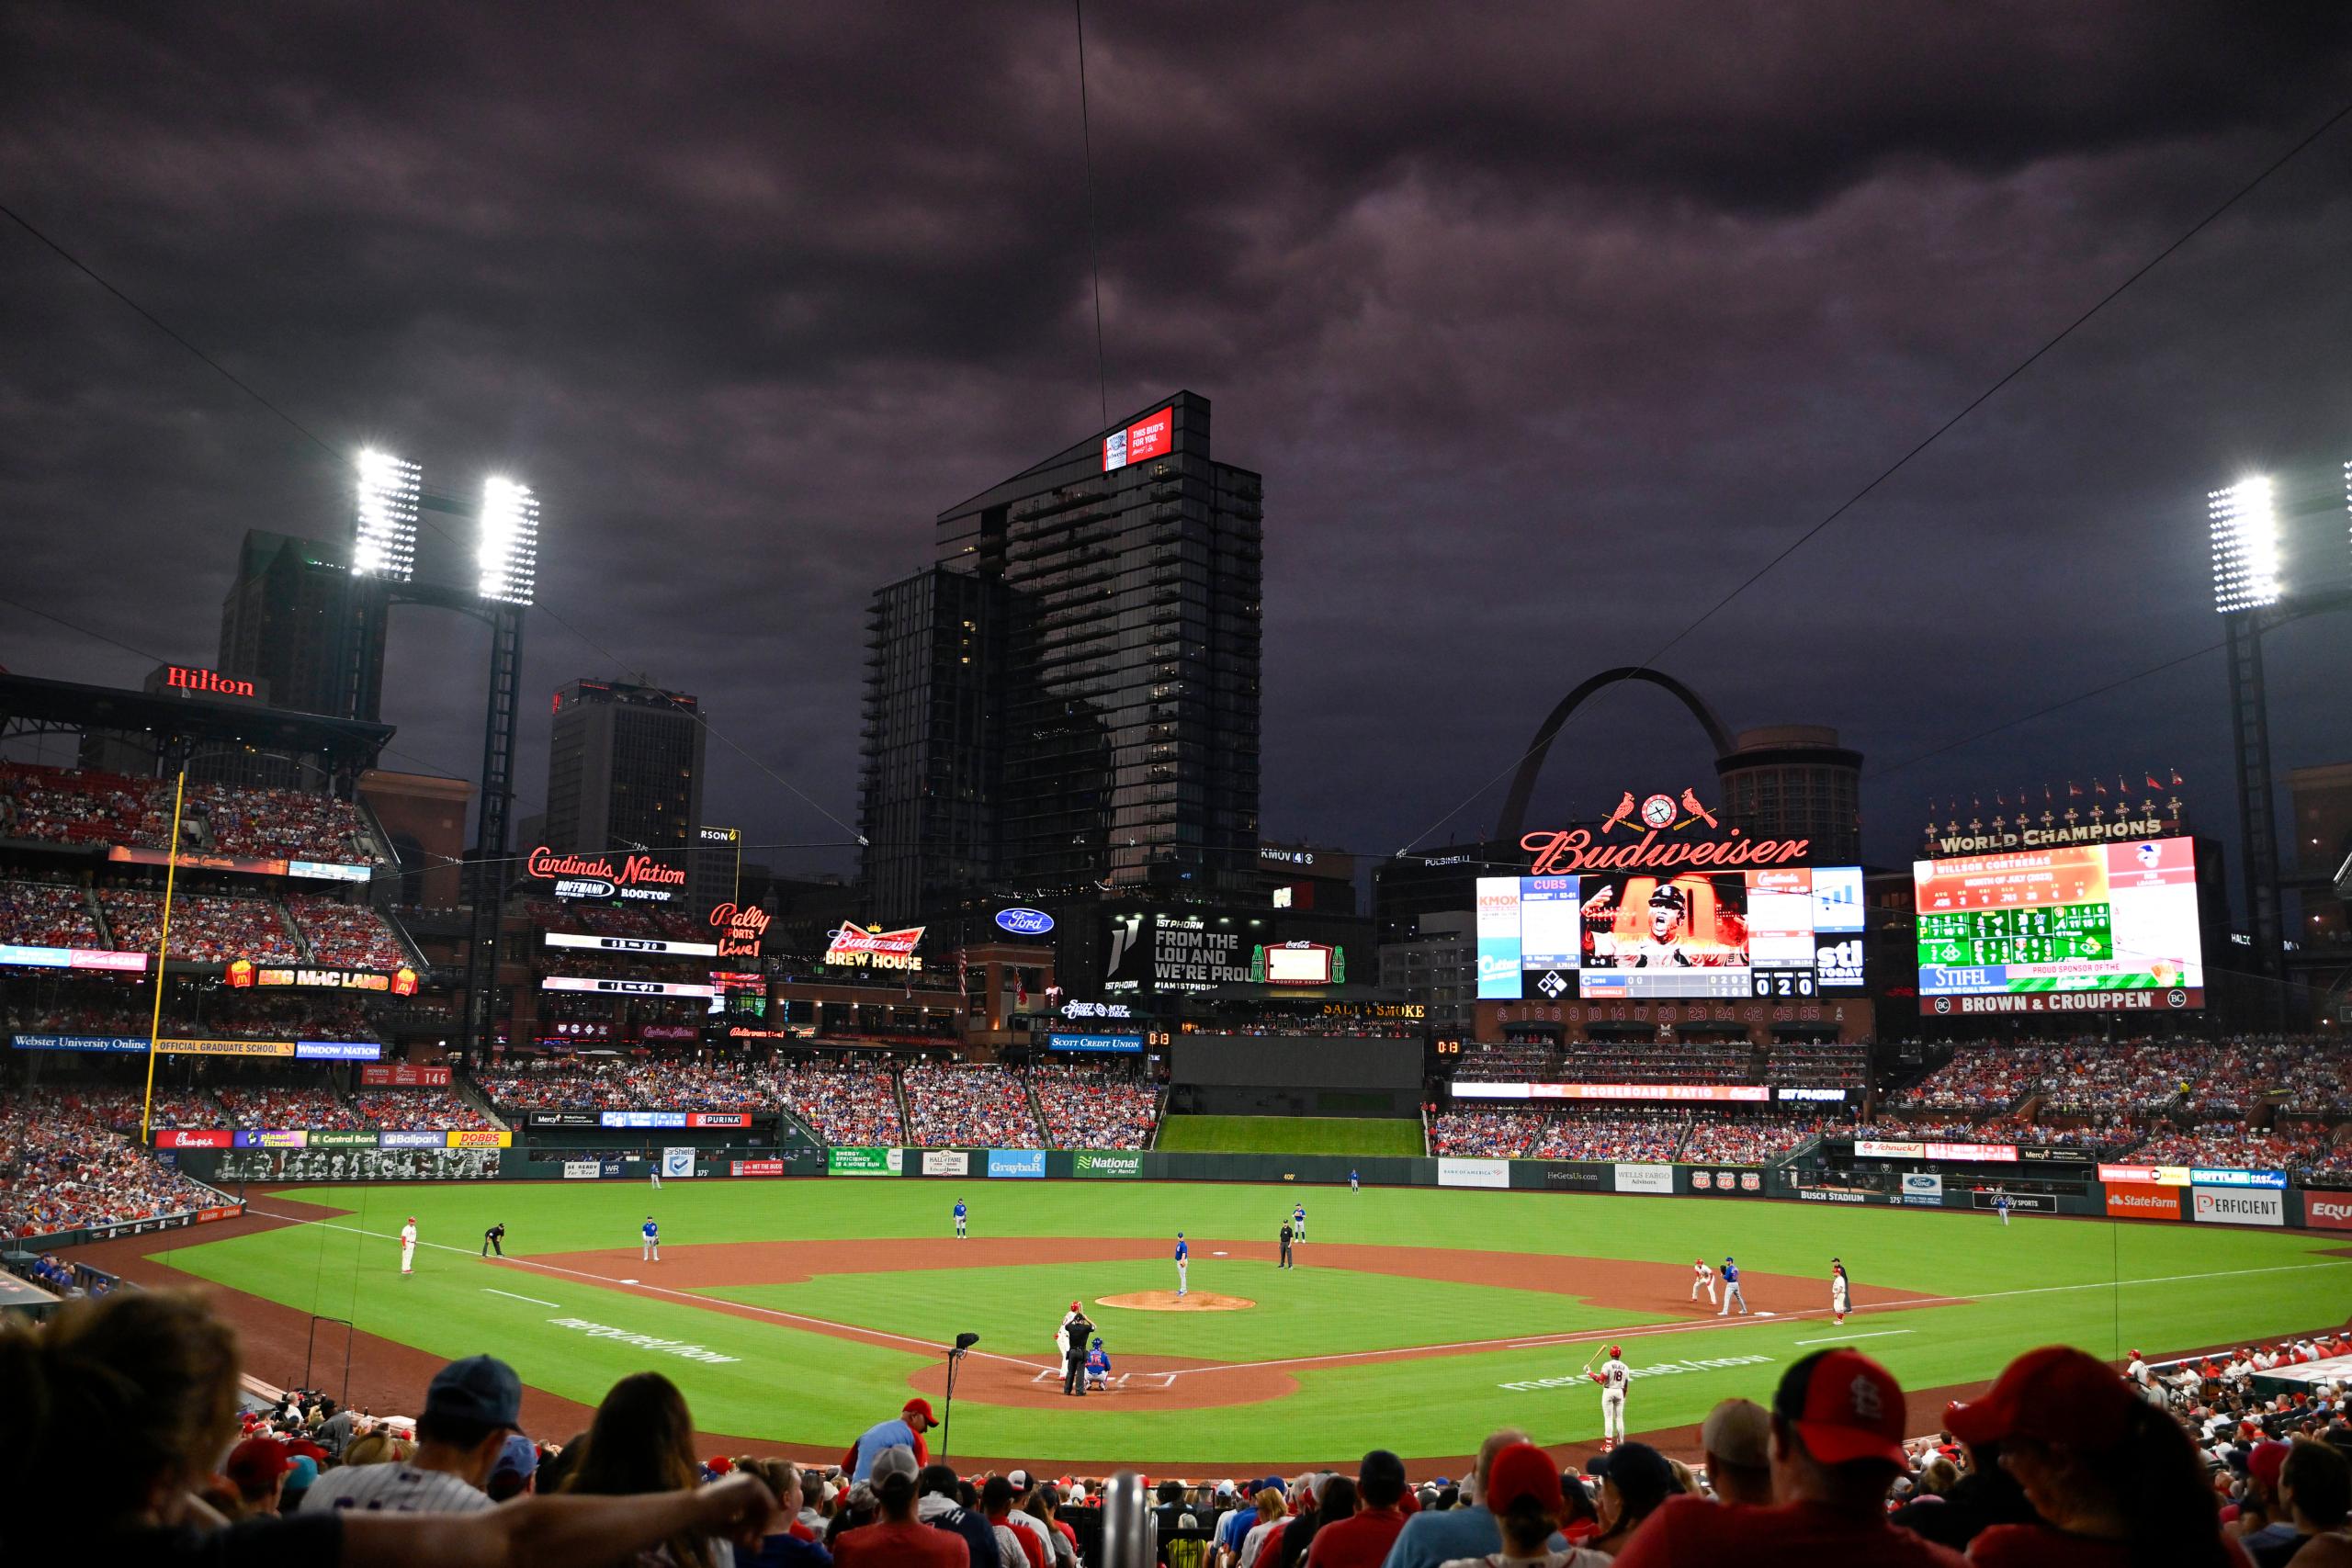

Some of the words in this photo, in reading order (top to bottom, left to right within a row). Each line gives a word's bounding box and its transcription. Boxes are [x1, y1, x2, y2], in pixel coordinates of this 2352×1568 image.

[1133, 428, 1146, 439] THIS
[1147, 423, 1164, 434] BUD'S
[1132, 438, 1144, 447] FOR
[167, 667, 254, 697] Hilton
[701, 830, 728, 840] RSON
[1940, 834, 2018, 853] WORLD
[2023, 818, 2162, 845] CHAMPIONS
[1261, 848, 1291, 862] KMOV
[1294, 853, 1303, 863] 4
[1521, 829, 1809, 875] Budweiser
[528, 846, 614, 878] Cardinals
[614, 855, 685, 886] Nation
[1425, 855, 1470, 866] POLSINELLI
[1937, 862, 1983, 874] WILLSON
[1986, 857, 2051, 870] CONTRERAS
[556, 880, 605, 895] HOFFMANN
[1534, 879, 1566, 889] CUBS
[1964, 877, 1994, 886] MONTH
[1996, 875, 2007, 885] OF
[621, 888, 671, 901] ROOFTOP
[1479, 896, 1518, 906] KMOX
[710, 903, 771, 935] Bally
[1009, 909, 1042, 931] Ford
[722, 928, 755, 939] SPORTS
[1156, 931, 1203, 947] FROM
[1206, 933, 1238, 949] THE
[718, 939, 761, 956] Live!
[1285, 941, 1311, 949] Coca-Cola
[826, 951, 869, 966] BREW
[873, 954, 922, 970] HOUSE
[1156, 947, 1186, 963] LOU
[1191, 949, 1227, 964] AND
[1816, 941, 1863, 967] stl
[1155, 963, 1206, 980] WE'RE
[1212, 966, 1254, 982] PROU
[1818, 967, 1863, 977] TODAY
[2059, 964, 2093, 973] SPONSOR
[258, 969, 295, 985] BIG
[297, 969, 340, 987] MAC
[342, 973, 389, 990] LAND
[1936, 968, 1990, 987] STIFEL
[1155, 982, 1218, 991] #IAM1STPHOR
[1757, 979, 1769, 995] 0
[1778, 979, 1791, 995] 2
[1799, 979, 1812, 995] 0
[1962, 996, 2027, 1011] BROWN
[2032, 998, 2043, 1010] &
[2050, 992, 2152, 1010] CROUPPEN
[2171, 994, 2183, 1002] BC
[1378, 1005, 1424, 1018] SMOKE
[1521, 1007, 1527, 1021] 1
[1535, 1007, 1544, 1021] 2
[1552, 1007, 1561, 1021] 6
[1569, 1007, 1578, 1021] 9
[1588, 1007, 1602, 1021] 10
[1611, 1007, 1625, 1021] 14
[1634, 1007, 1648, 1021] 17
[1658, 1007, 1676, 1021] 20
[1688, 1007, 1707, 1021] 23
[1715, 1007, 1735, 1021] 24
[1744, 1007, 1763, 1021] 42
[1773, 1007, 1792, 1021] 45
[1800, 1007, 1819, 1021] 85
[15, 1035, 55, 1046] Webster
[59, 1038, 110, 1049] University
[113, 1039, 146, 1050] Online
[1052, 1038, 1079, 1046] SCOTT
[1080, 1038, 1111, 1047] CREDIT
[1113, 1039, 1139, 1048] UNION
[1149, 1032, 1169, 1045] 0:13
[160, 1042, 197, 1051] OFFICIAL
[200, 1043, 243, 1053] GRADUATE
[246, 1044, 277, 1054] SCHOOL
[297, 1044, 340, 1055] WINDOW
[343, 1045, 379, 1055] NATION
[1438, 1042, 1458, 1054] 0:13
[425, 1073, 446, 1084] 146
[1581, 1087, 1668, 1098] SCOREBOARD
[1673, 1088, 1713, 1098] PATIO
[538, 1115, 557, 1123] Mercy
[707, 1115, 739, 1123] PURINA
[175, 1132, 213, 1146] Chick-fil-A
[261, 1134, 290, 1142] planet
[264, 1139, 295, 1147] fitness
[397, 1134, 440, 1145] Ballpark
[461, 1134, 500, 1142] DOBBS
[2026, 1149, 2045, 1160] Mercy
[1091, 1157, 1138, 1168] National
[1547, 1172, 1598, 1180] HeGetsUs.com
[1618, 1171, 1644, 1179] WELLS
[1645, 1171, 1670, 1179] FARGO
[1912, 1178, 1930, 1187] Ford
[1801, 1190, 1826, 1201] BUSCH
[1829, 1192, 1864, 1202] STADIUM
[1890, 1196, 1902, 1204] 375'
[2018, 1199, 2039, 1207] SPORTS
[2196, 1195, 2278, 1215] PERFICIENT
[2312, 1203, 2352, 1220] EQU
[1613, 1370, 1623, 1382] 18
